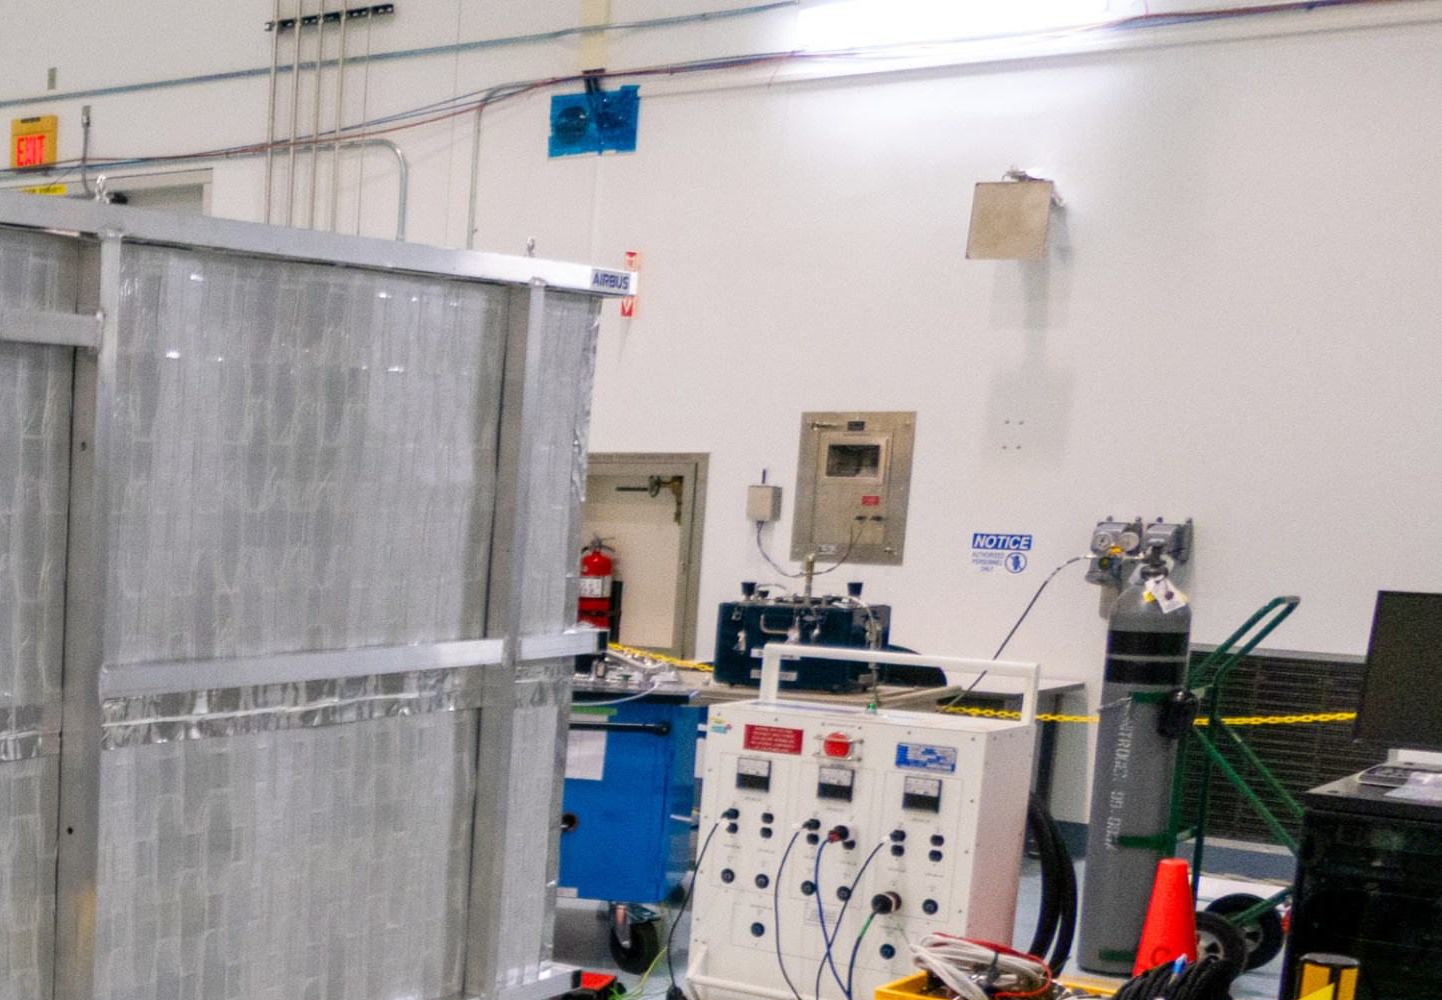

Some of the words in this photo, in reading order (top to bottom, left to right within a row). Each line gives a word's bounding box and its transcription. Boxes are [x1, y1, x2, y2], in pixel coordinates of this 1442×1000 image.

[17, 134, 46, 167] EXIT
[592, 272, 629, 290] AIRBUS
[974, 535, 1031, 550] NOTICE
